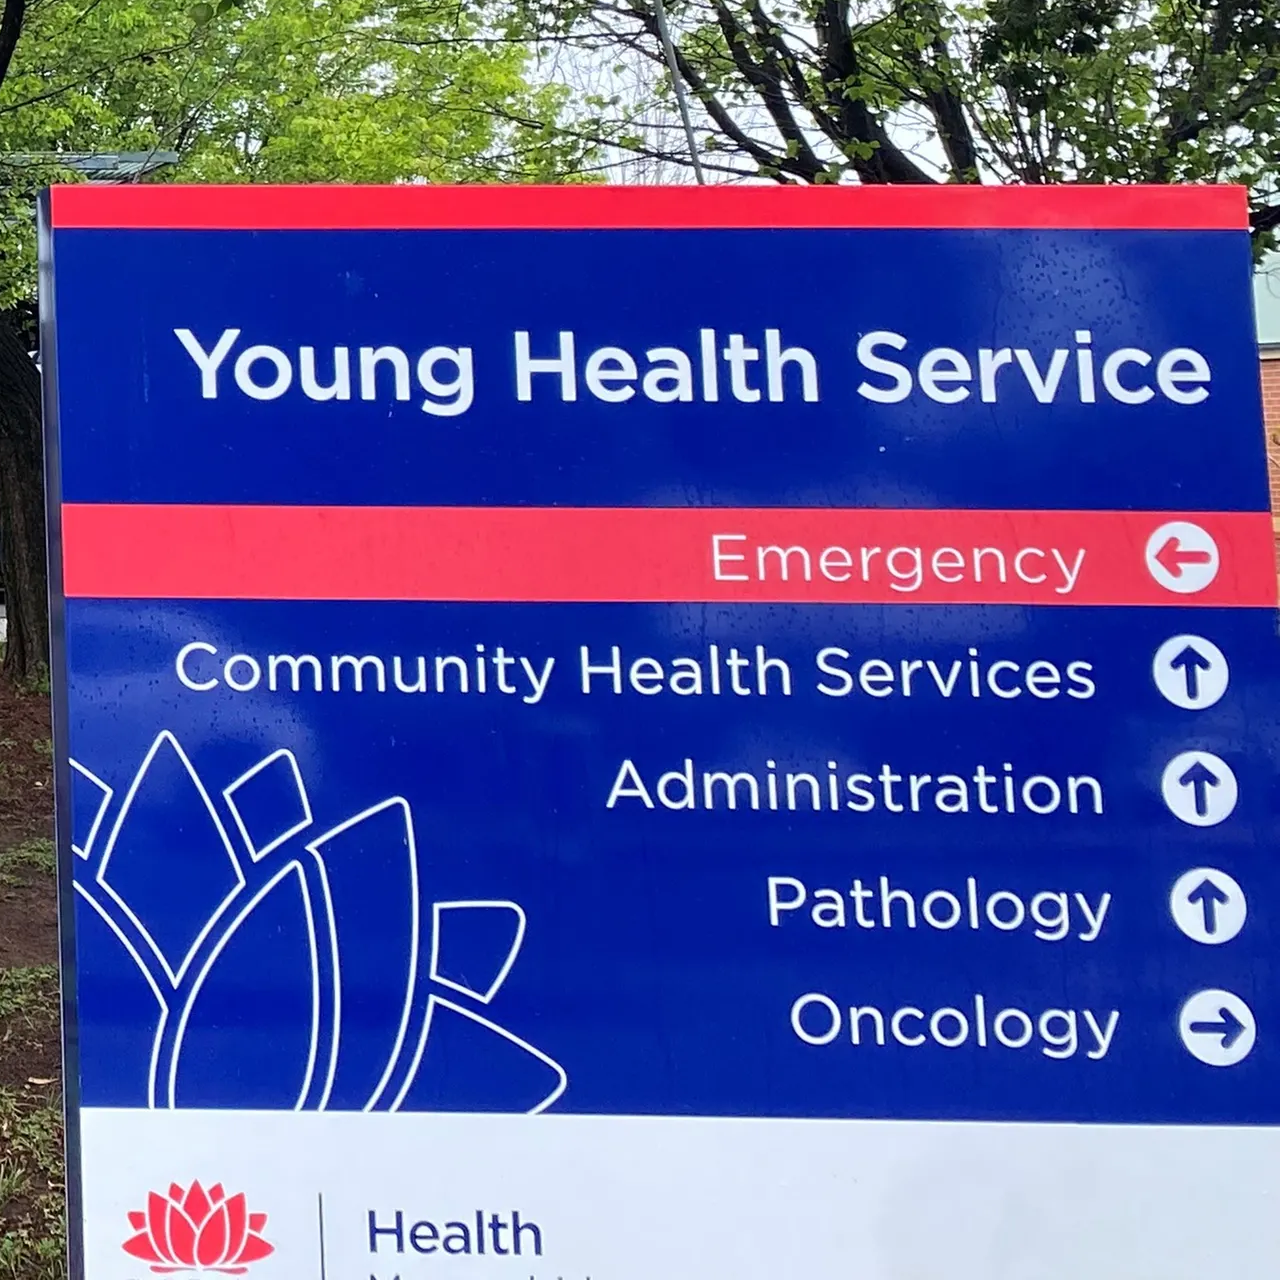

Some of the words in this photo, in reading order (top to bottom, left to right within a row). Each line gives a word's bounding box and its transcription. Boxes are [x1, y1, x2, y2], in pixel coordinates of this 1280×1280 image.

[172, 328, 475, 417] Young
[514, 328, 819, 403] Health
[857, 329, 1211, 405] Service
[712, 534, 1086, 594] Emergency
[175, 641, 555, 704] Community
[580, 643, 791, 696] Health
[816, 647, 1095, 699] Services
[606, 757, 1103, 815] Administration
[768, 876, 1111, 942] Pathology
[791, 993, 1120, 1059] Oncology
[368, 1210, 542, 1256] Health
